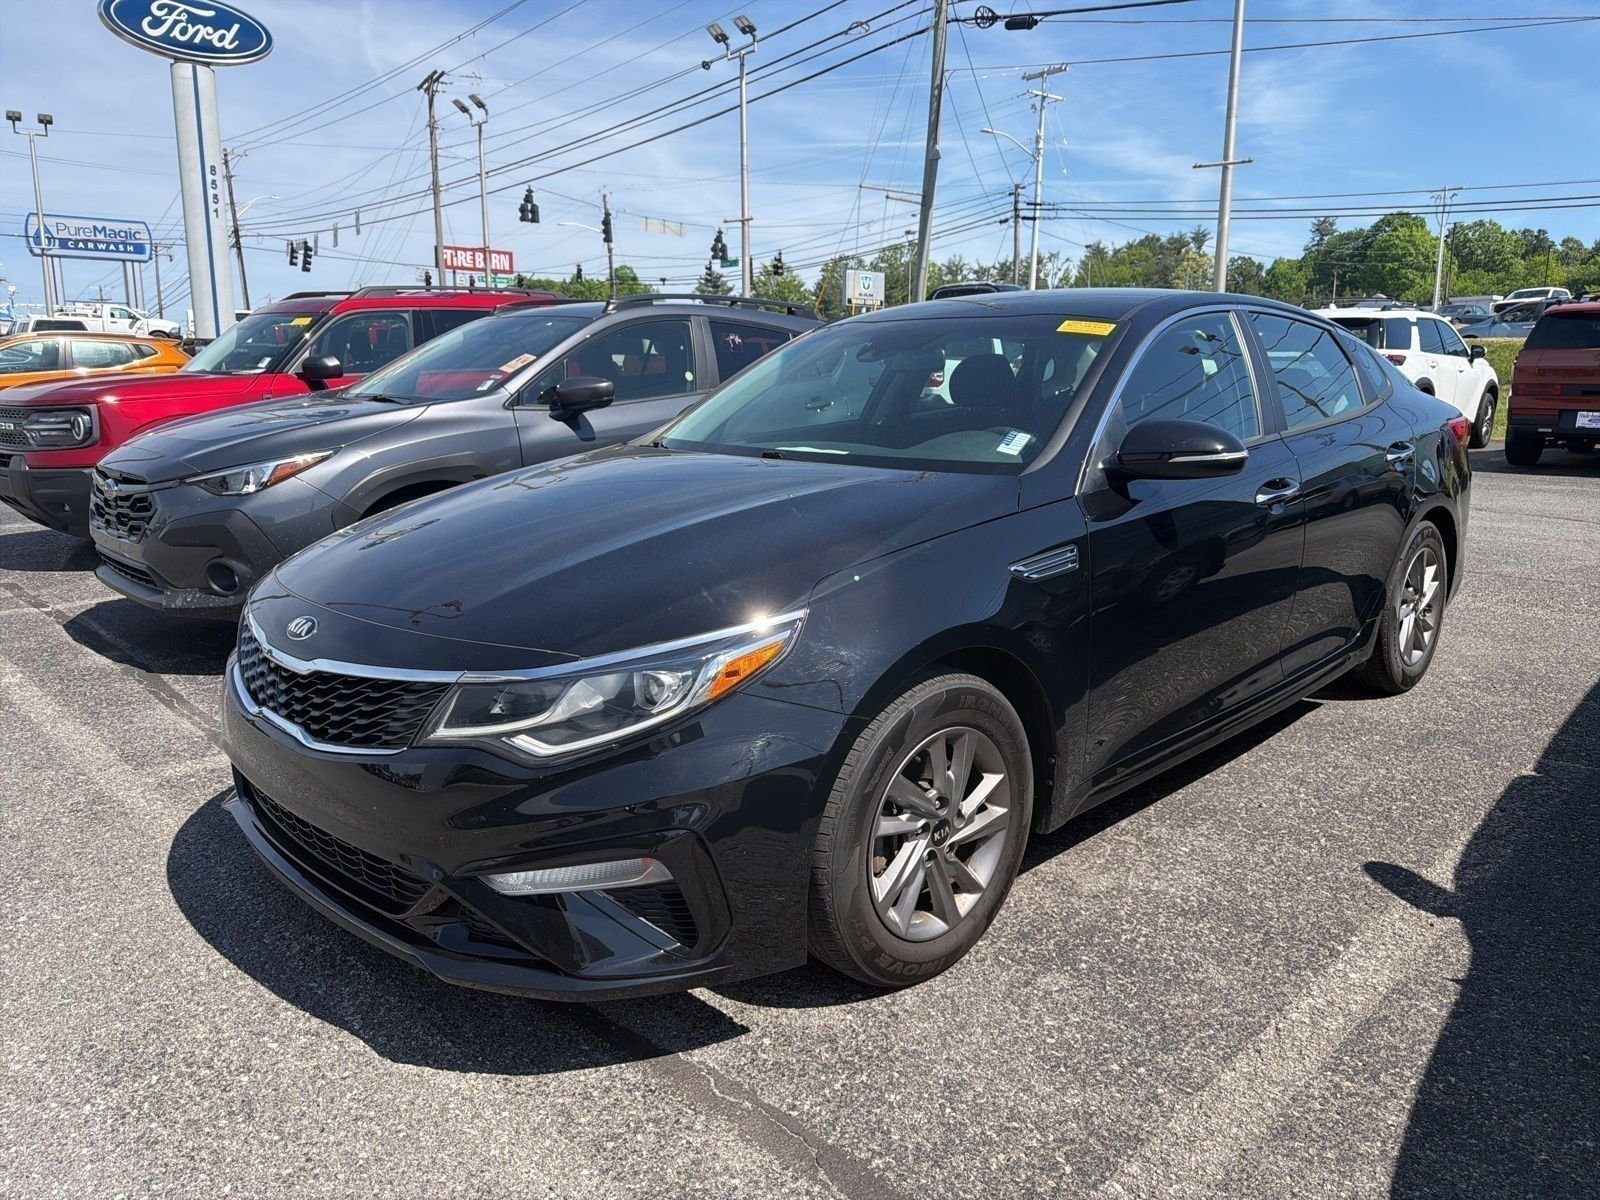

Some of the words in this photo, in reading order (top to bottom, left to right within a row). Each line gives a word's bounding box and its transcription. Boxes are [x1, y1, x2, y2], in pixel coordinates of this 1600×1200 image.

[142, 0, 240, 50] Ford
[210, 165, 219, 219] 8551
[56, 222, 142, 241] PureMagic
[67, 241, 135, 252] CARWASH
[475, 252, 510, 271] BRN
[289, 618, 313, 637] KIA
[933, 825, 950, 841] KIA
